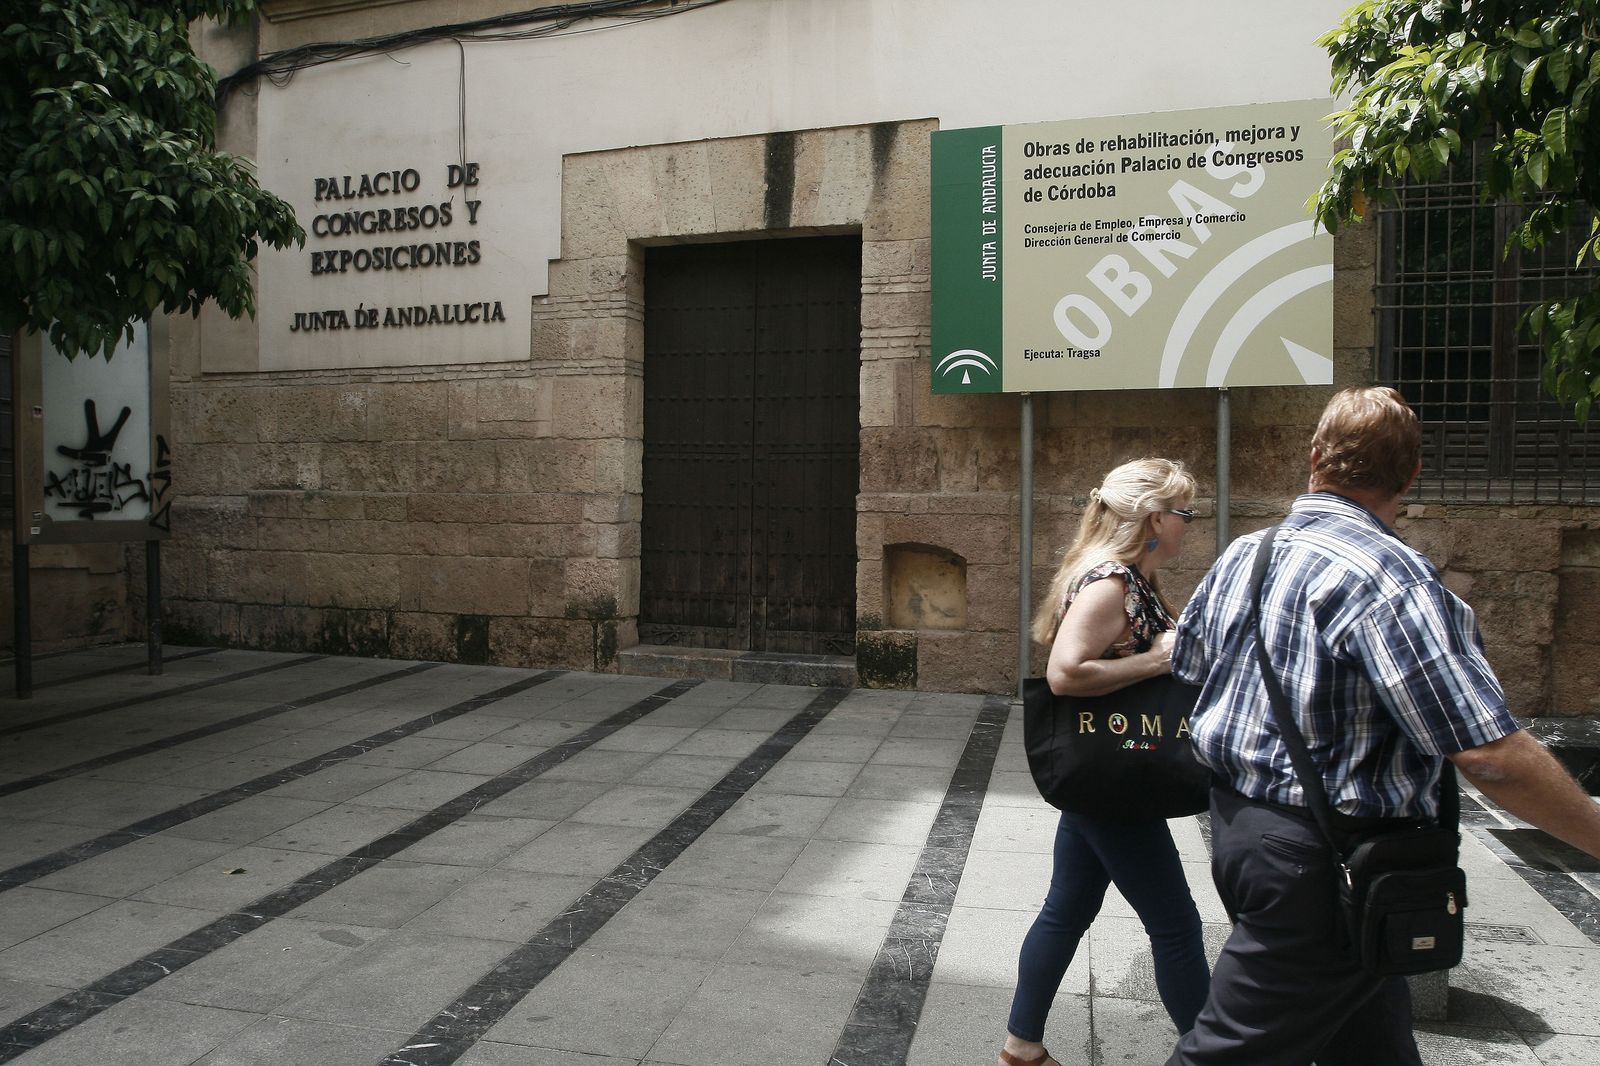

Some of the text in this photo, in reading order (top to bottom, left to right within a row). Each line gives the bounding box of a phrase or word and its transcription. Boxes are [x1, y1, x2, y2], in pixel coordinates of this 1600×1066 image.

[1023, 124, 1301, 158] Obras de rehabilitación, mejora y
[1023, 148, 1304, 181] adecuación Palacio de Congresos
[314, 162, 480, 201] PALACIO DE
[1023, 182, 1117, 203] de Córdoba
[312, 200, 482, 238] CONGRESOS Y
[982, 219, 997, 236] DE
[1024, 211, 1247, 235] Consejería de Empleo, Empresa y Comercio
[1024, 229, 1182, 248] Dirección General de Comercio
[1053, 141, 1266, 350] OBRAS
[311, 240, 481, 275] EXPOSICIONES
[982, 240, 997, 282] JUNTA
[290, 309, 350, 332] JUNTA
[1023, 347, 1101, 361] Ejecuta: Tragsa
[1078, 711, 1192, 739] ROMA
